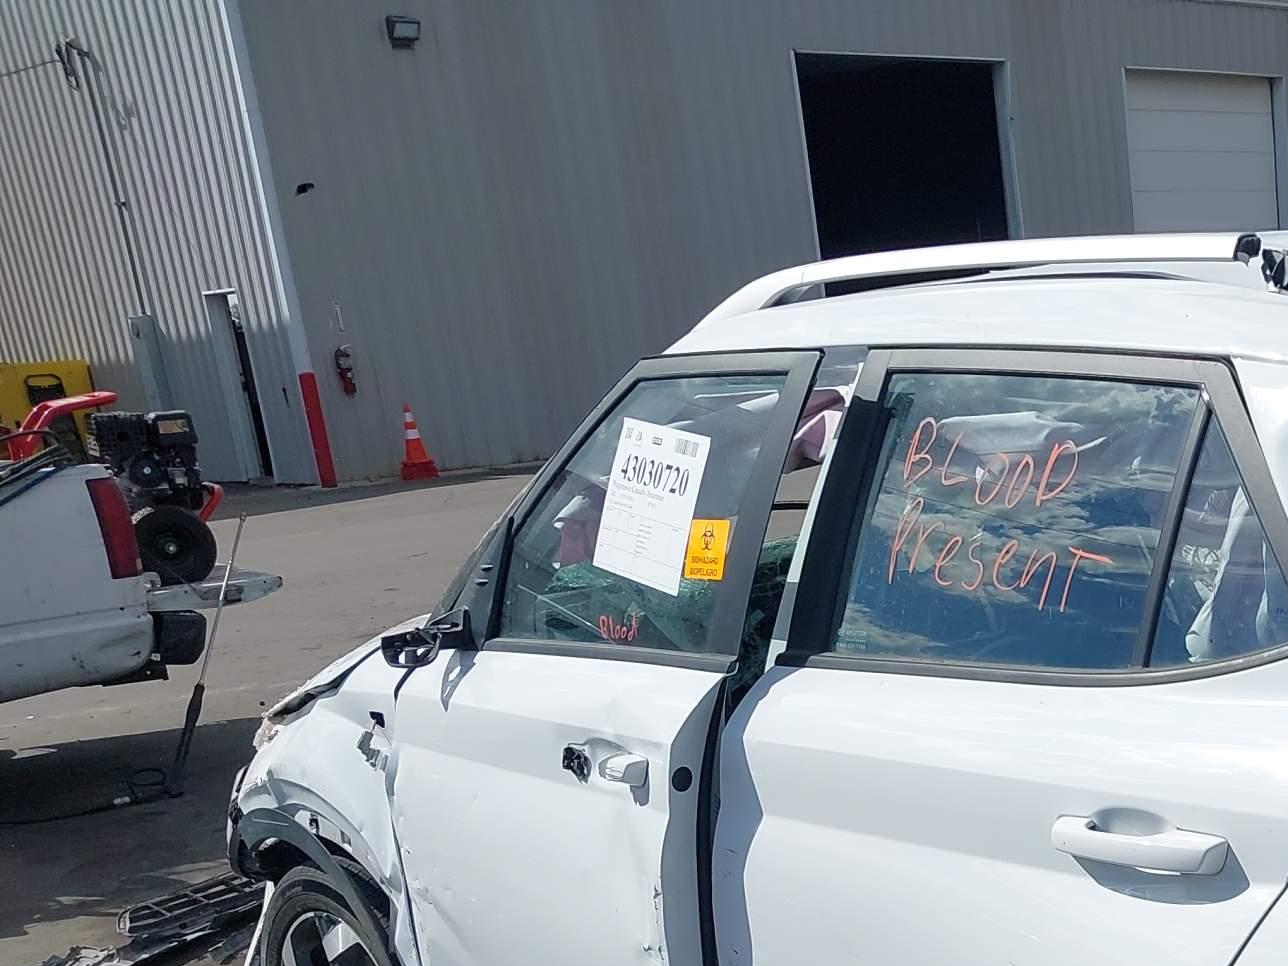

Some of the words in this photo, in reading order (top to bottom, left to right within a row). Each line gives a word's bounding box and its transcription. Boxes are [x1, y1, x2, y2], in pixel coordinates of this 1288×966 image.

[620, 453, 690, 497] 43030720
[903, 416, 1080, 510] BLOOD
[599, 611, 638, 641] Blood
